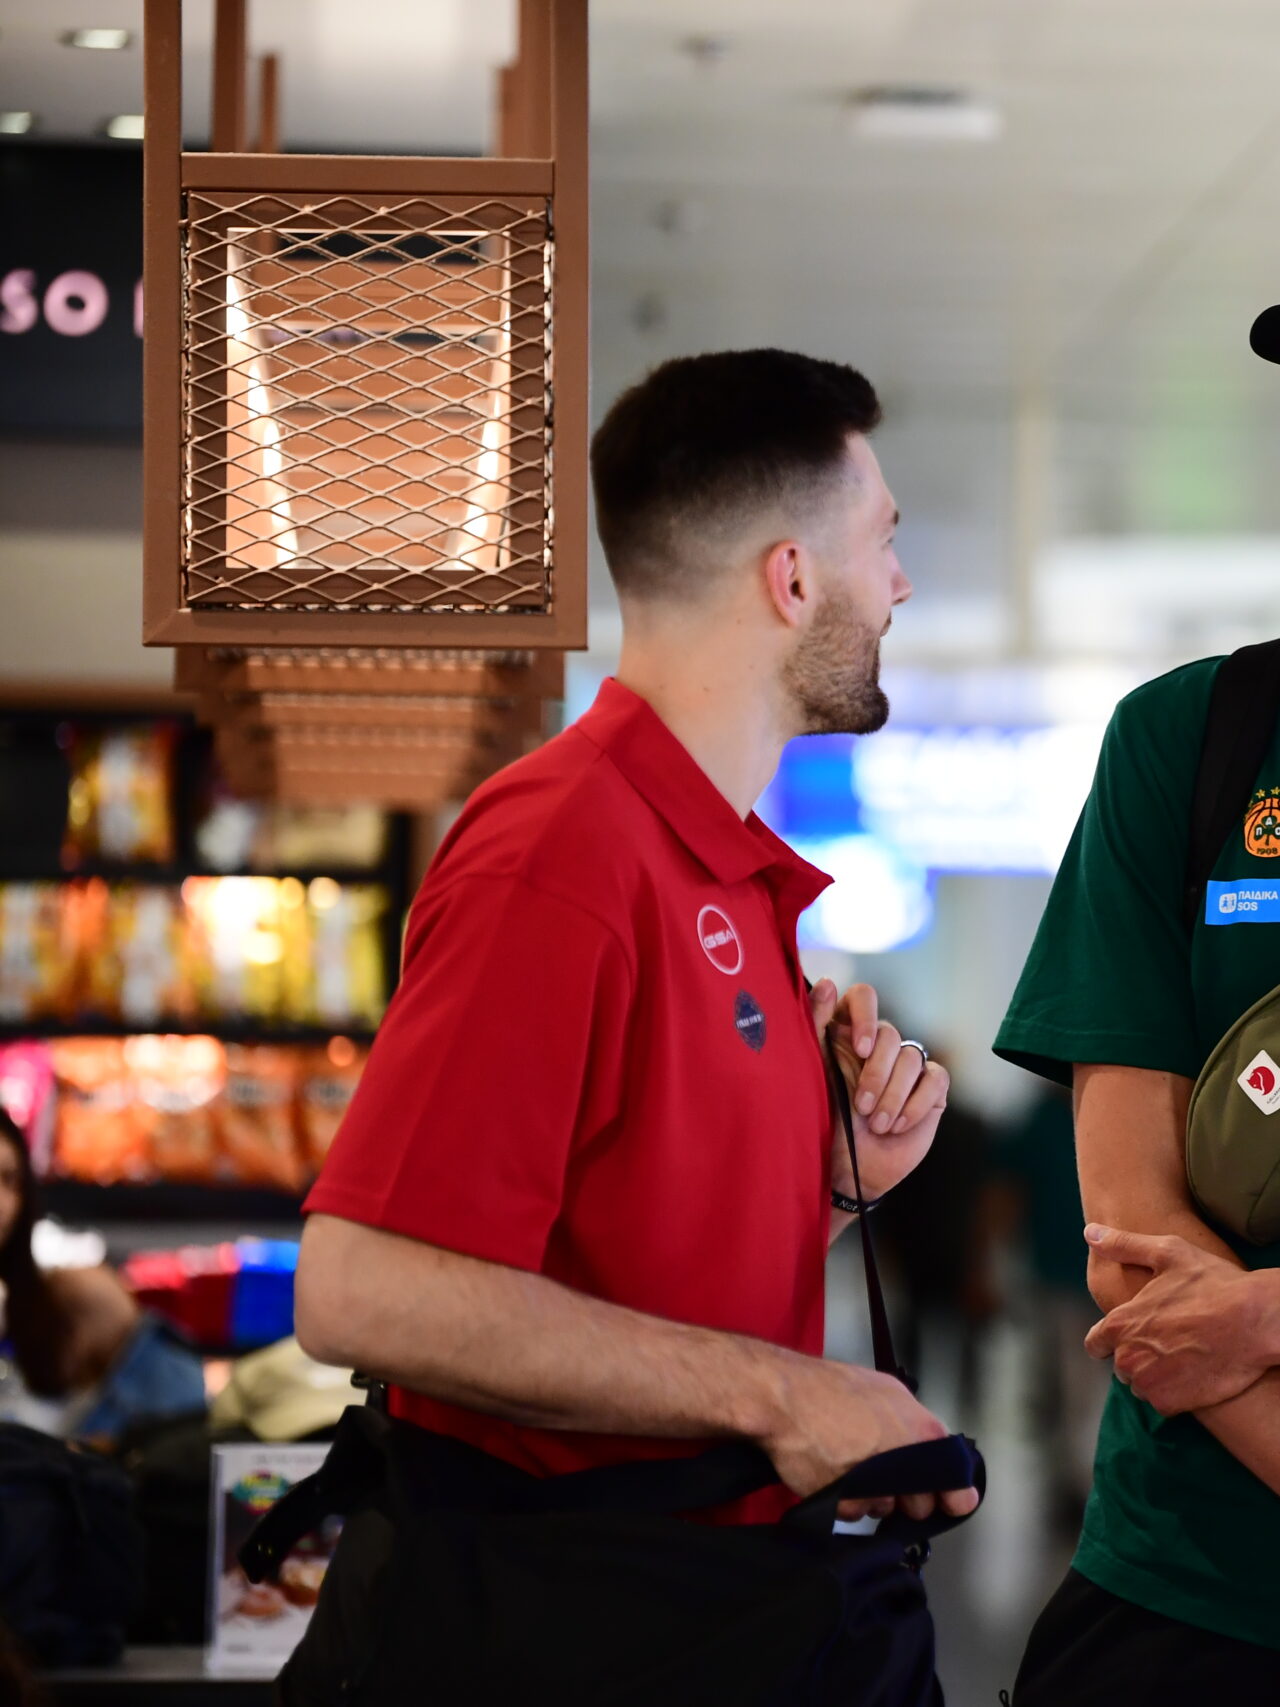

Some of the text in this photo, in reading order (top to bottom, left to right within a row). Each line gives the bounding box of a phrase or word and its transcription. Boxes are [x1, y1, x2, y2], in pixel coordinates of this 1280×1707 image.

[1256, 847, 1278, 855] 1908
[1238, 891, 1278, 900] ΠΑΙΔΙΚΑ
[1237, 902, 1258, 911] SOS
